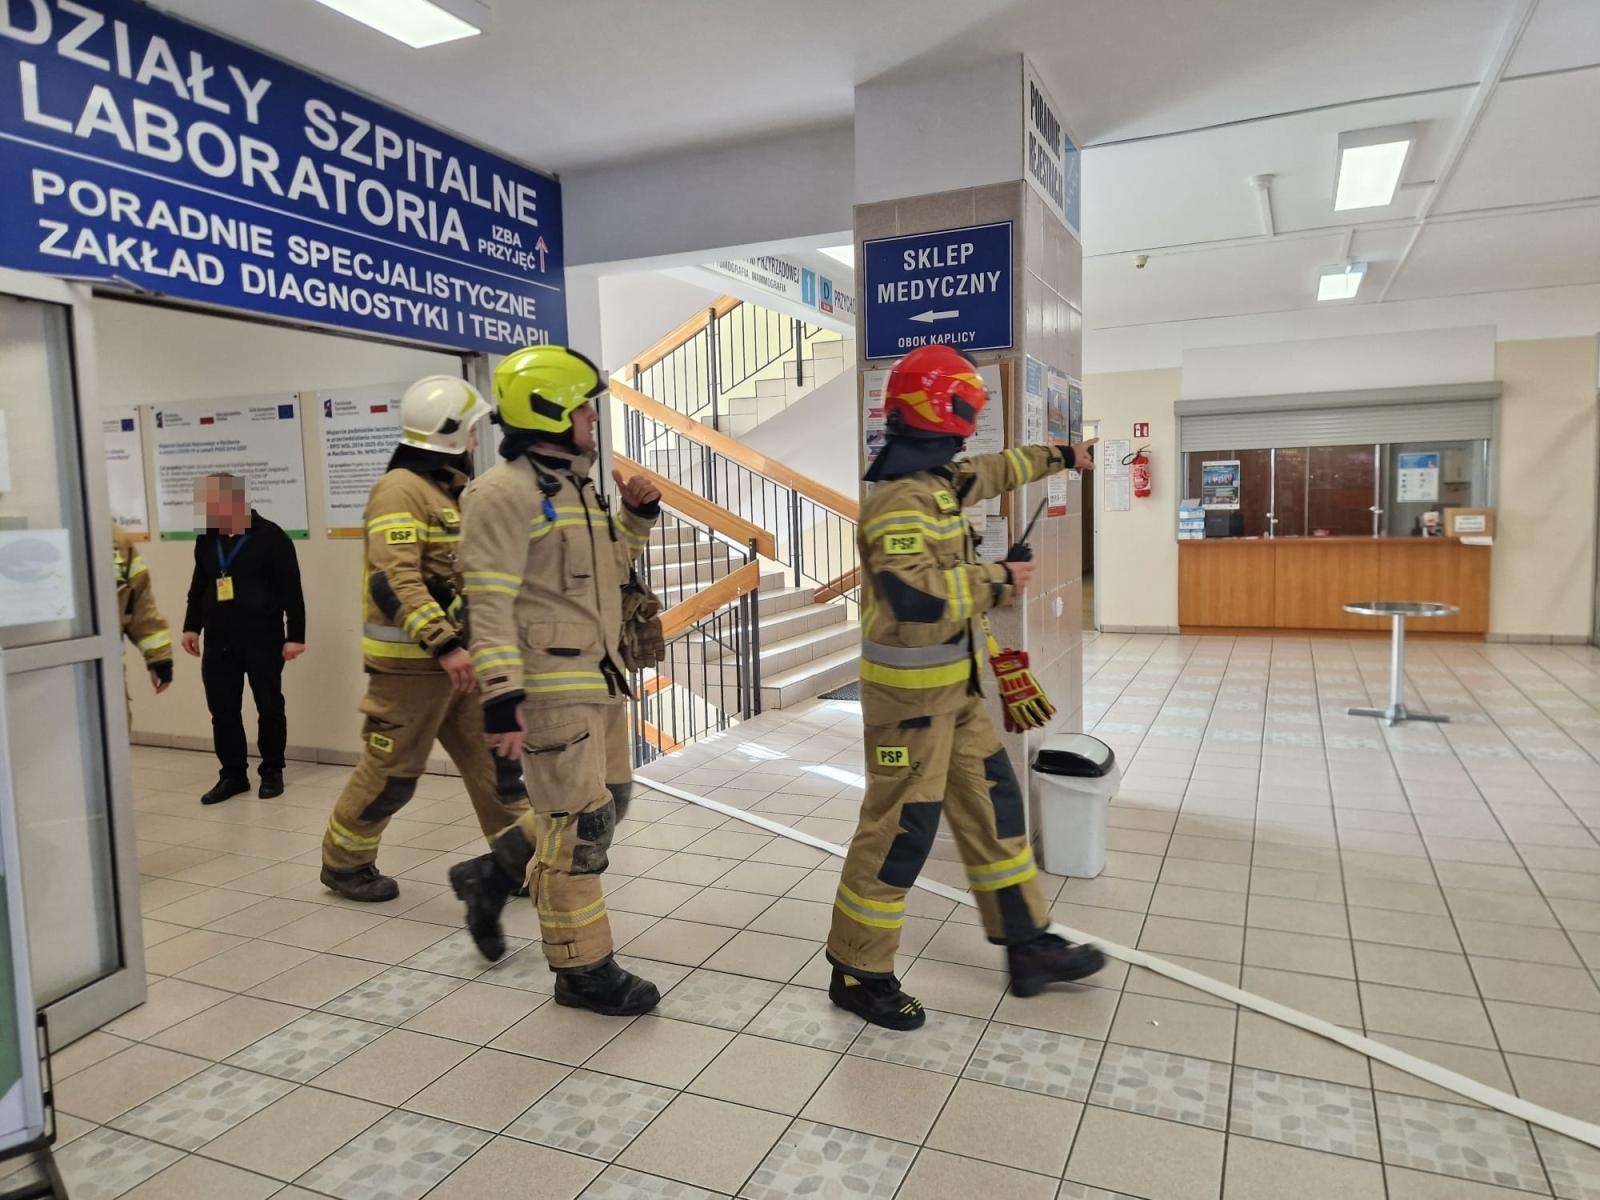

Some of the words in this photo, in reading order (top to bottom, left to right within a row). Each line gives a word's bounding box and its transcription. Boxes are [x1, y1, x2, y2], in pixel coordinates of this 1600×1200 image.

[0, 0, 271, 124] DZIAŁY
[304, 99, 538, 226] SZPITALNE
[20, 61, 470, 251] LABORATORIA
[32, 169, 274, 258] PORADNIE
[288, 235, 536, 319] SPECJALISTYCZNE
[492, 225, 521, 247] IZBA
[478, 239, 535, 270] PRZYJĘĆ
[903, 243, 974, 271] SKLEP
[39, 219, 224, 286] ZAKŁAD
[241, 263, 448, 331] DIAGNOSTYKI
[458, 312, 464, 334] I
[470, 314, 549, 345] TERAPII
[877, 270, 1001, 304] MEDYCZNY
[898, 336, 927, 348] OBOK
[930, 331, 976, 344] KAPLICY
[880, 750, 903, 763] PSP
